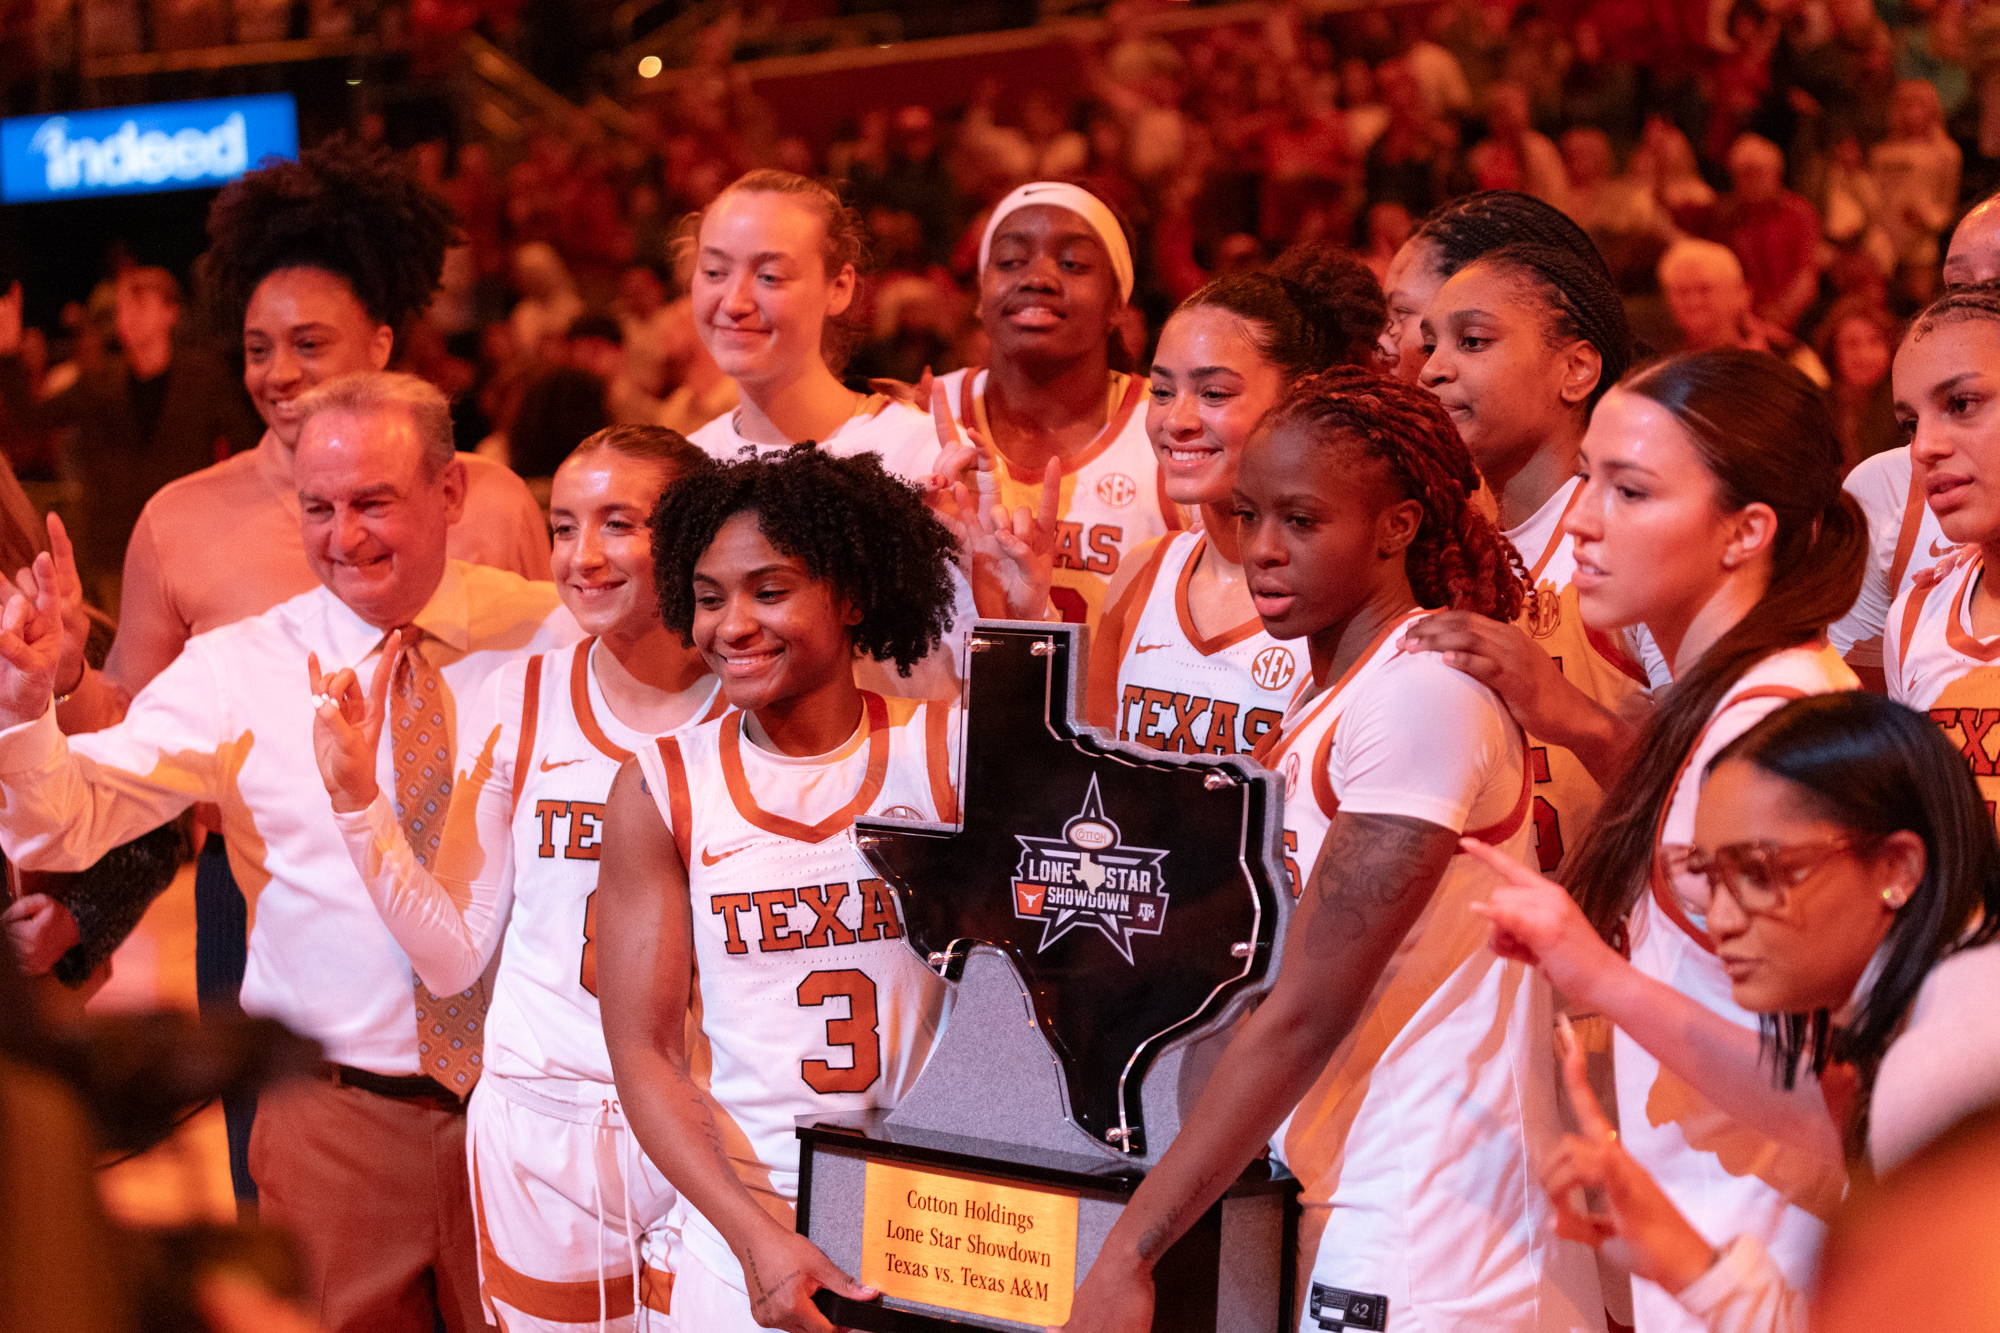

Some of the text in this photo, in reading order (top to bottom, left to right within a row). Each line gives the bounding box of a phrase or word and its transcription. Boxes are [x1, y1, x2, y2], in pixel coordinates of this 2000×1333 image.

[28, 111, 248, 190] indeed
[1098, 473, 1136, 507] SEC
[1053, 521, 1123, 575] AS
[1252, 647, 1295, 690] SEC
[1119, 684, 1284, 756] TEXAS
[535, 799, 605, 861] TE
[1029, 859, 1151, 893] LONE STAR
[1047, 886, 1130, 913] SHOWDOWN
[710, 878, 901, 955] TEXA
[797, 968, 881, 1095] 3
[907, 1190, 1034, 1234] Cotton Holdings
[886, 1220, 1051, 1267] Lone Star Showdown
[885, 1252, 1049, 1301] Texas vs. Texas A&M
[1351, 1302, 1370, 1319] 42
